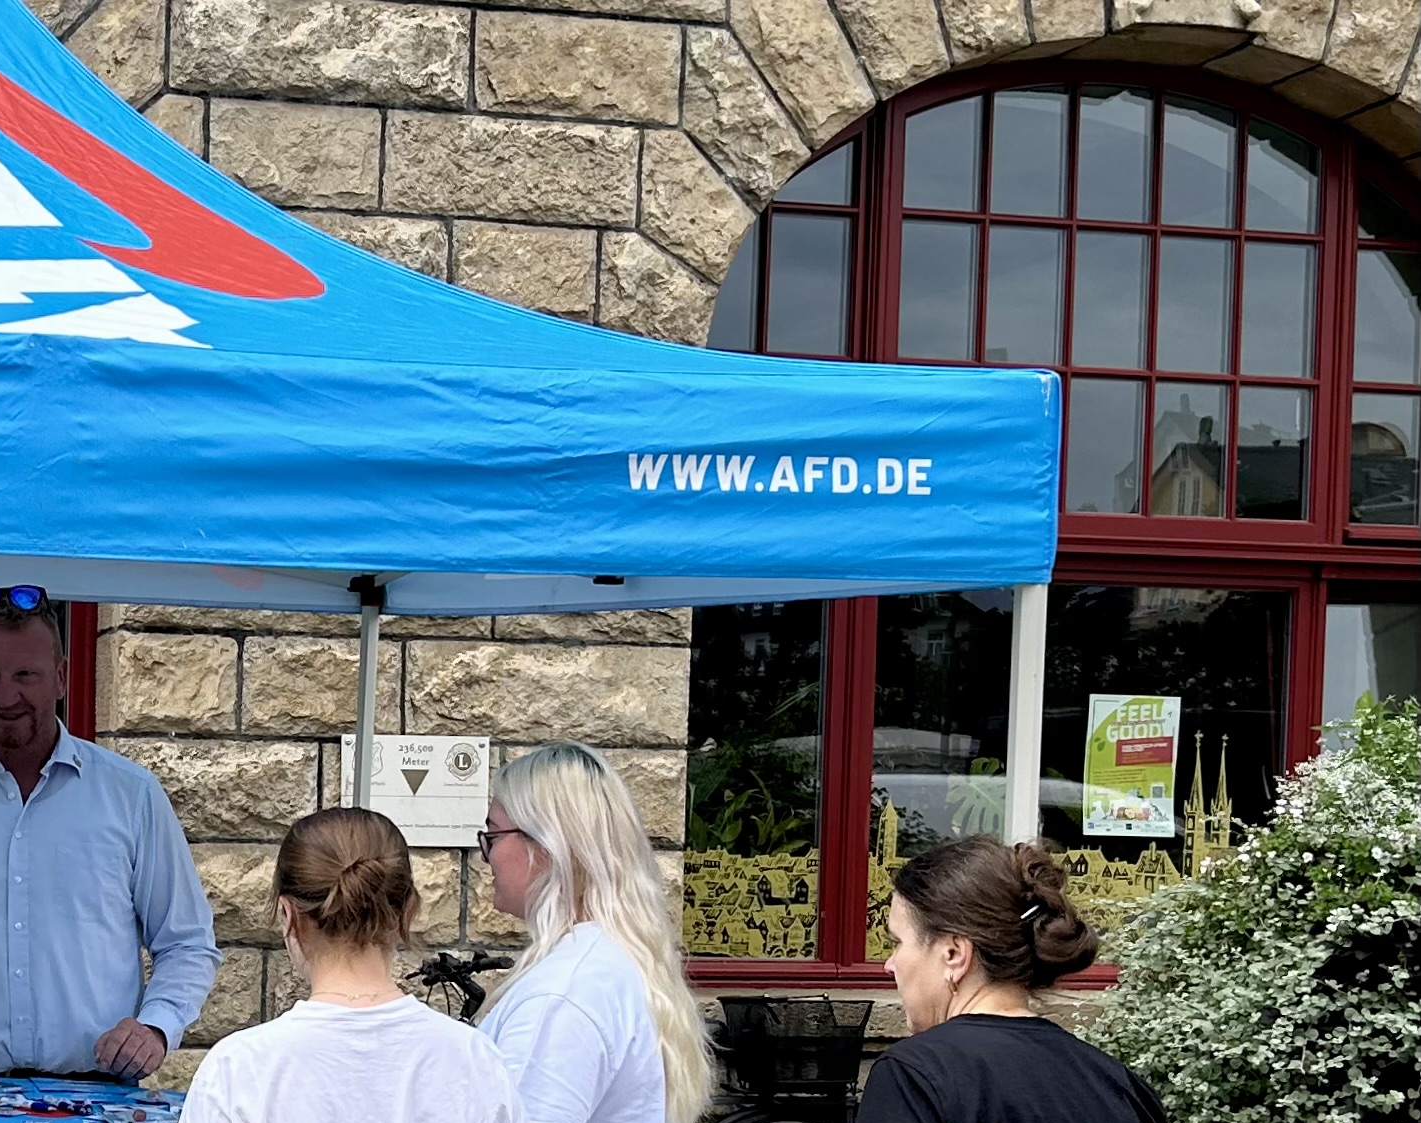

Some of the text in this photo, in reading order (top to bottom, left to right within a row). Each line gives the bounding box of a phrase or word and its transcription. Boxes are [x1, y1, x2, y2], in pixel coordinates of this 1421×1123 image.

[627, 453, 933, 496] WWW.AFD.DE
[1116, 703, 1164, 723] FEEL
[401, 756, 430, 766] Meter
